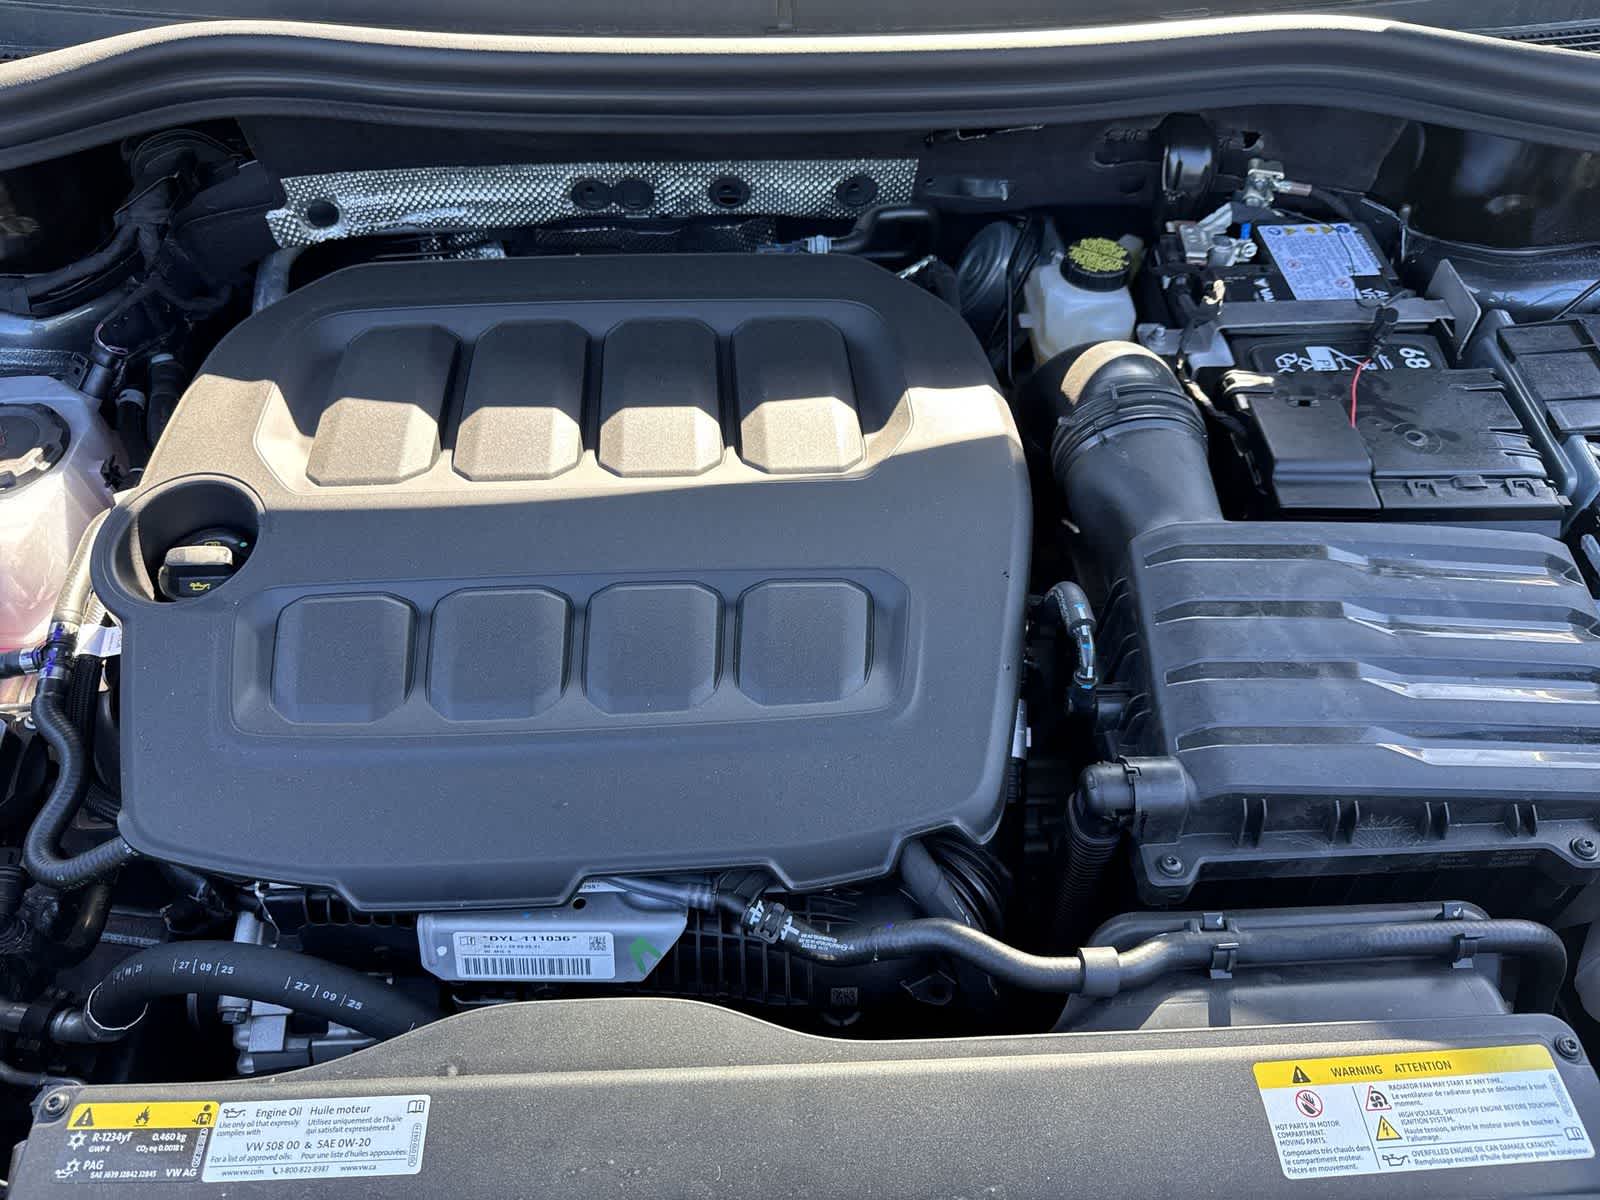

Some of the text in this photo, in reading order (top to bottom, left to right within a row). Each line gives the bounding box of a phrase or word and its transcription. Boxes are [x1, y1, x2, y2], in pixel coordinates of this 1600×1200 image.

[1399, 347, 1431, 369] 68
[178, 961, 234, 974] 27 09 25
[294, 981, 362, 1010] 27 09 25
[1330, 1060, 1452, 1077] WARNING ATTENTION
[256, 1106, 302, 1119] Engine Oil
[310, 1105, 371, 1115] Huile moteur
[232, 1121, 245, 1129] only
[270, 1119, 299, 1127] expressly
[333, 1117, 372, 1126] uniquement
[92, 1131, 187, 1144] R-1234yf 0.460 kg
[217, 1130, 245, 1138] complies
[246, 1142, 264, 1152] VW
[265, 1141, 284, 1151] 508
[286, 1140, 300, 1150] 00
[317, 1139, 336, 1148] SAE
[338, 1138, 371, 1147] 0W-20
[247, 1153, 278, 1162] approved
[1283, 1148, 1321, 1157] Composants
[83, 1160, 105, 1170] PAG
[1292, 1156, 1337, 1166] compartiment
[165, 1169, 197, 1177] VW AG
[1287, 1166, 1308, 1174] Pièces
